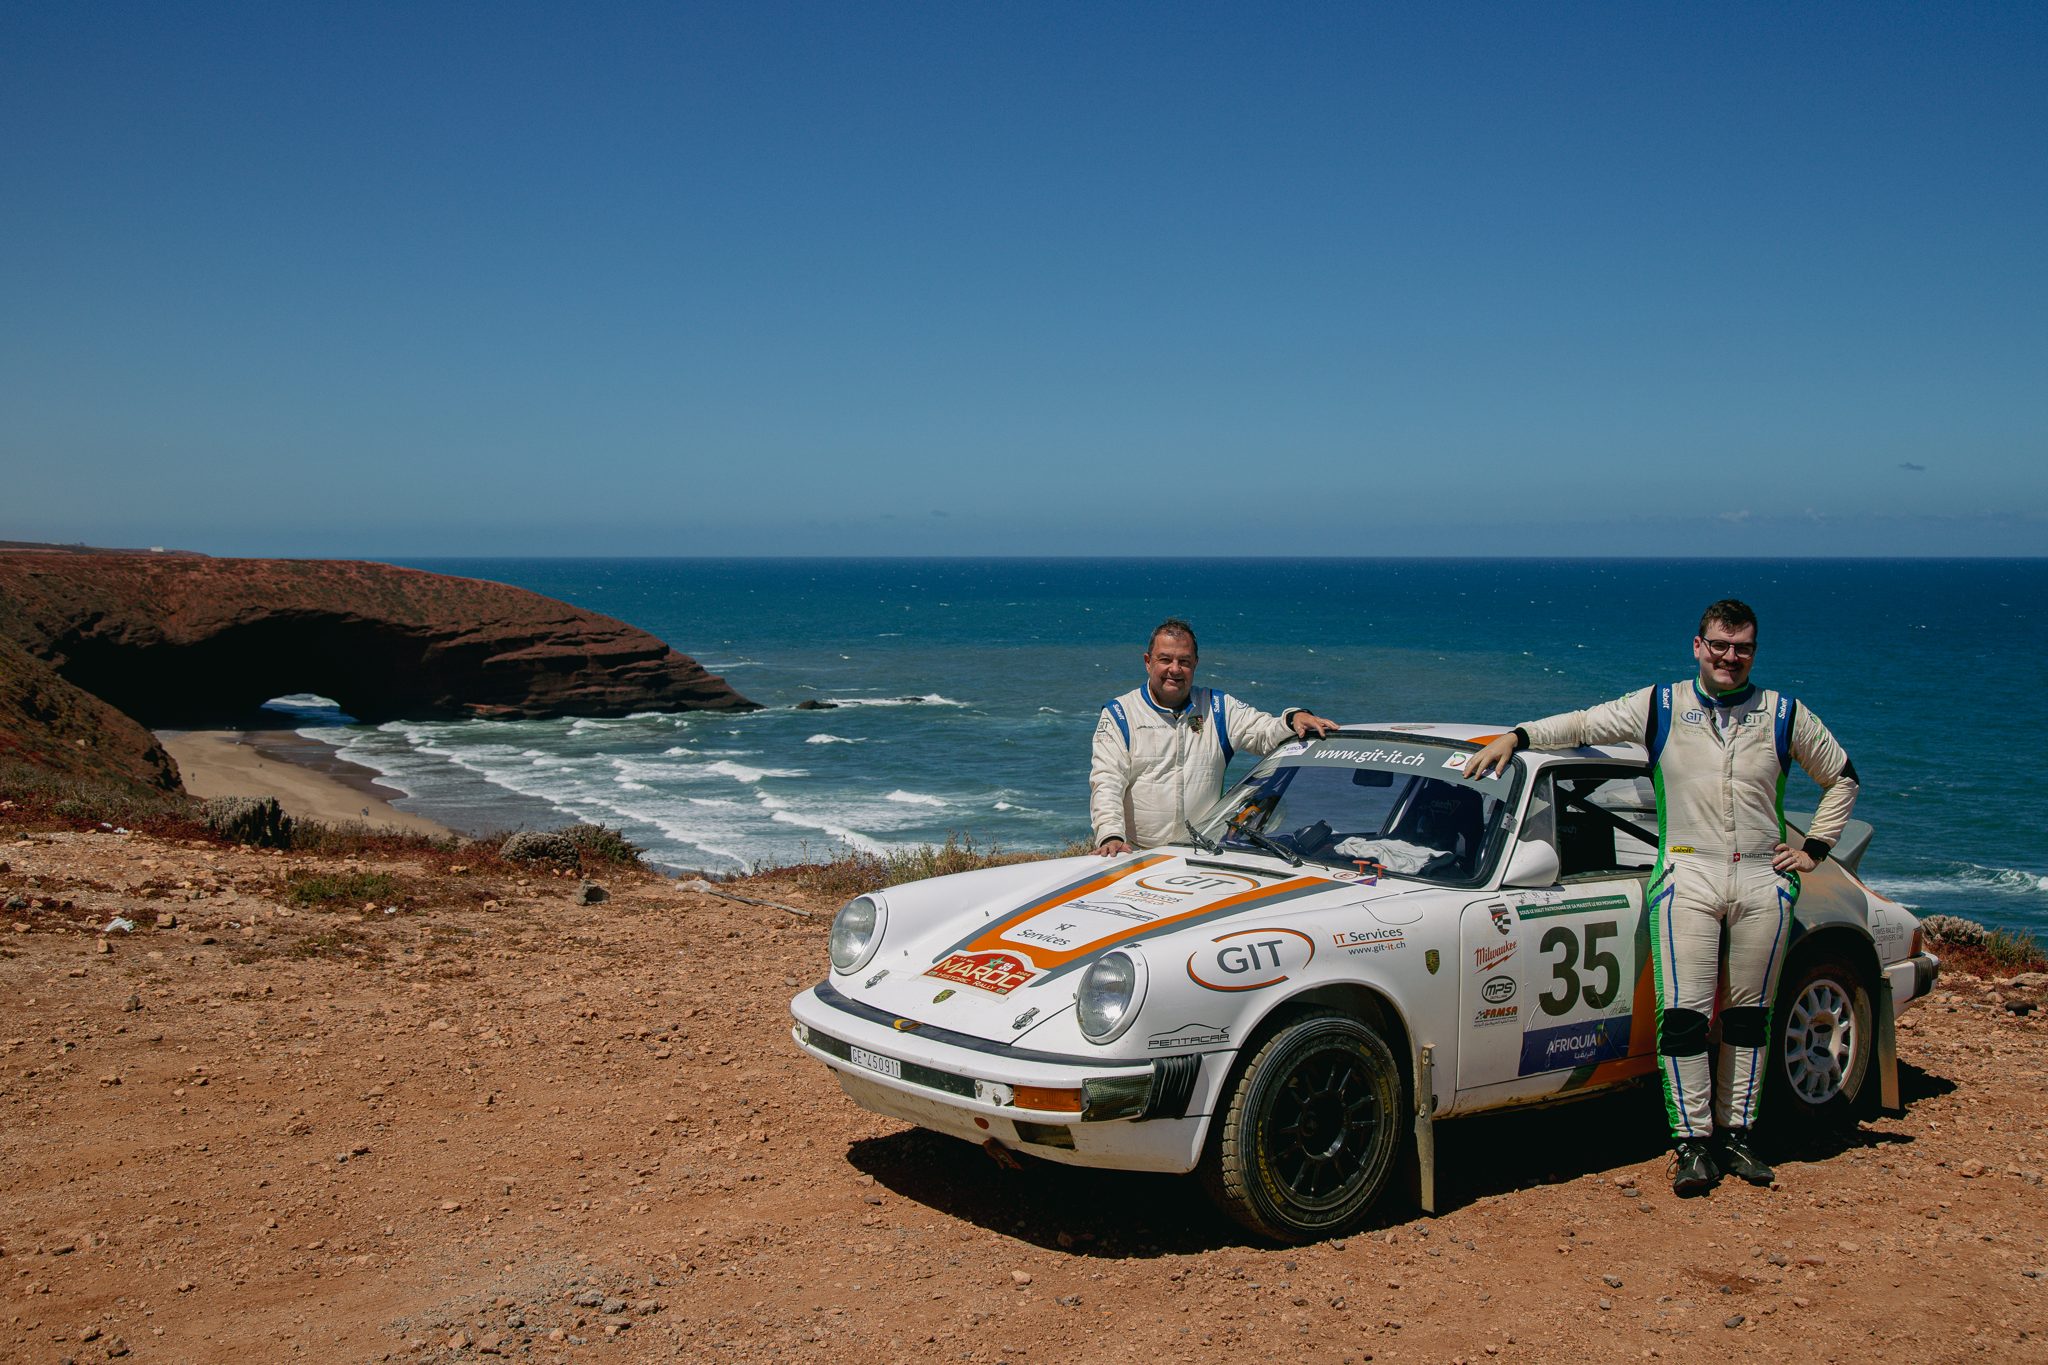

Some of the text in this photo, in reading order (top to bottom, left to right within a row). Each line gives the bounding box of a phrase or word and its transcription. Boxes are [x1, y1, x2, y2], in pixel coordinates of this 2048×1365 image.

[1686, 711, 1704, 721] GIT
[1743, 714, 1765, 723] GIT
[1314, 748, 1425, 767] www.git-it.ch
[1165, 875, 1236, 890] GIT
[1016, 929, 1071, 946] Services
[1332, 928, 1403, 945] IT Services
[1348, 941, 1407, 955] www.git-it.ch
[1474, 940, 1517, 967] Milwaukee
[1216, 939, 1284, 974] GIT
[934, 959, 1026, 989] MAROC
[1538, 920, 1621, 1017] 35
[972, 981, 997, 990] RALLY
[1485, 982, 1513, 997] MPS
[1484, 1006, 1518, 1019] FAMSA
[1148, 1033, 1230, 1048] PENTACAR
[1546, 1033, 1597, 1055] AFRIQUIA
